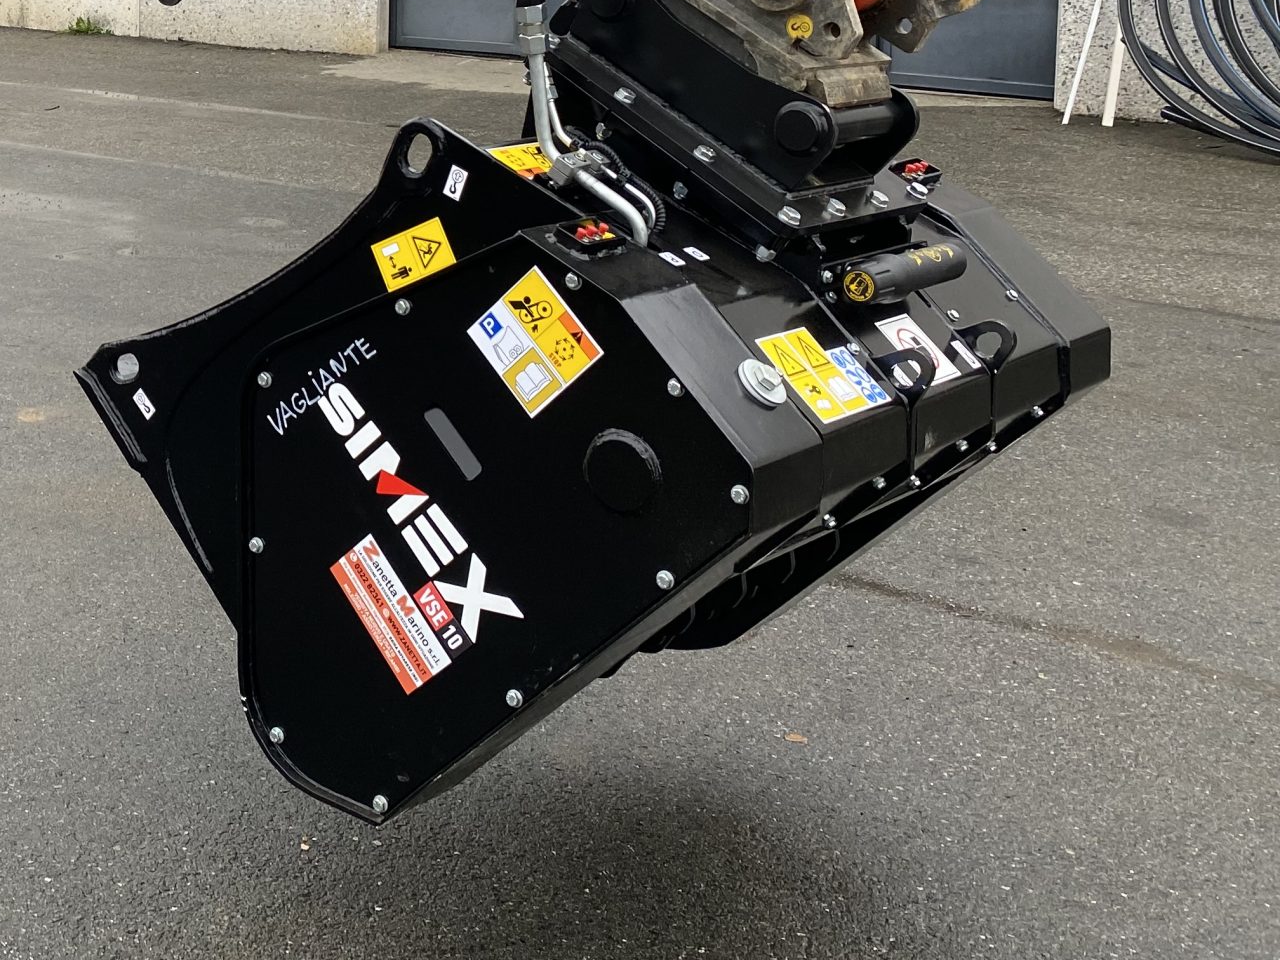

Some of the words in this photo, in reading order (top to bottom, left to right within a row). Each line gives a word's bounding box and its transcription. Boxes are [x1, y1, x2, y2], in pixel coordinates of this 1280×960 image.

[481, 317, 496, 336] P
[548, 352, 562, 368] STOP
[318, 382, 525, 644] SIMEX
[354, 563, 369, 586] 0322
[366, 583, 384, 608] 82341
[387, 616, 427, 676] WWW.ZANETTA.IT
[362, 540, 398, 598] Zanetta
[396, 594, 430, 647] Marino
[427, 647, 441, 666] s.r.l.
[419, 588, 449, 628] VSE
[441, 623, 463, 650] 10
